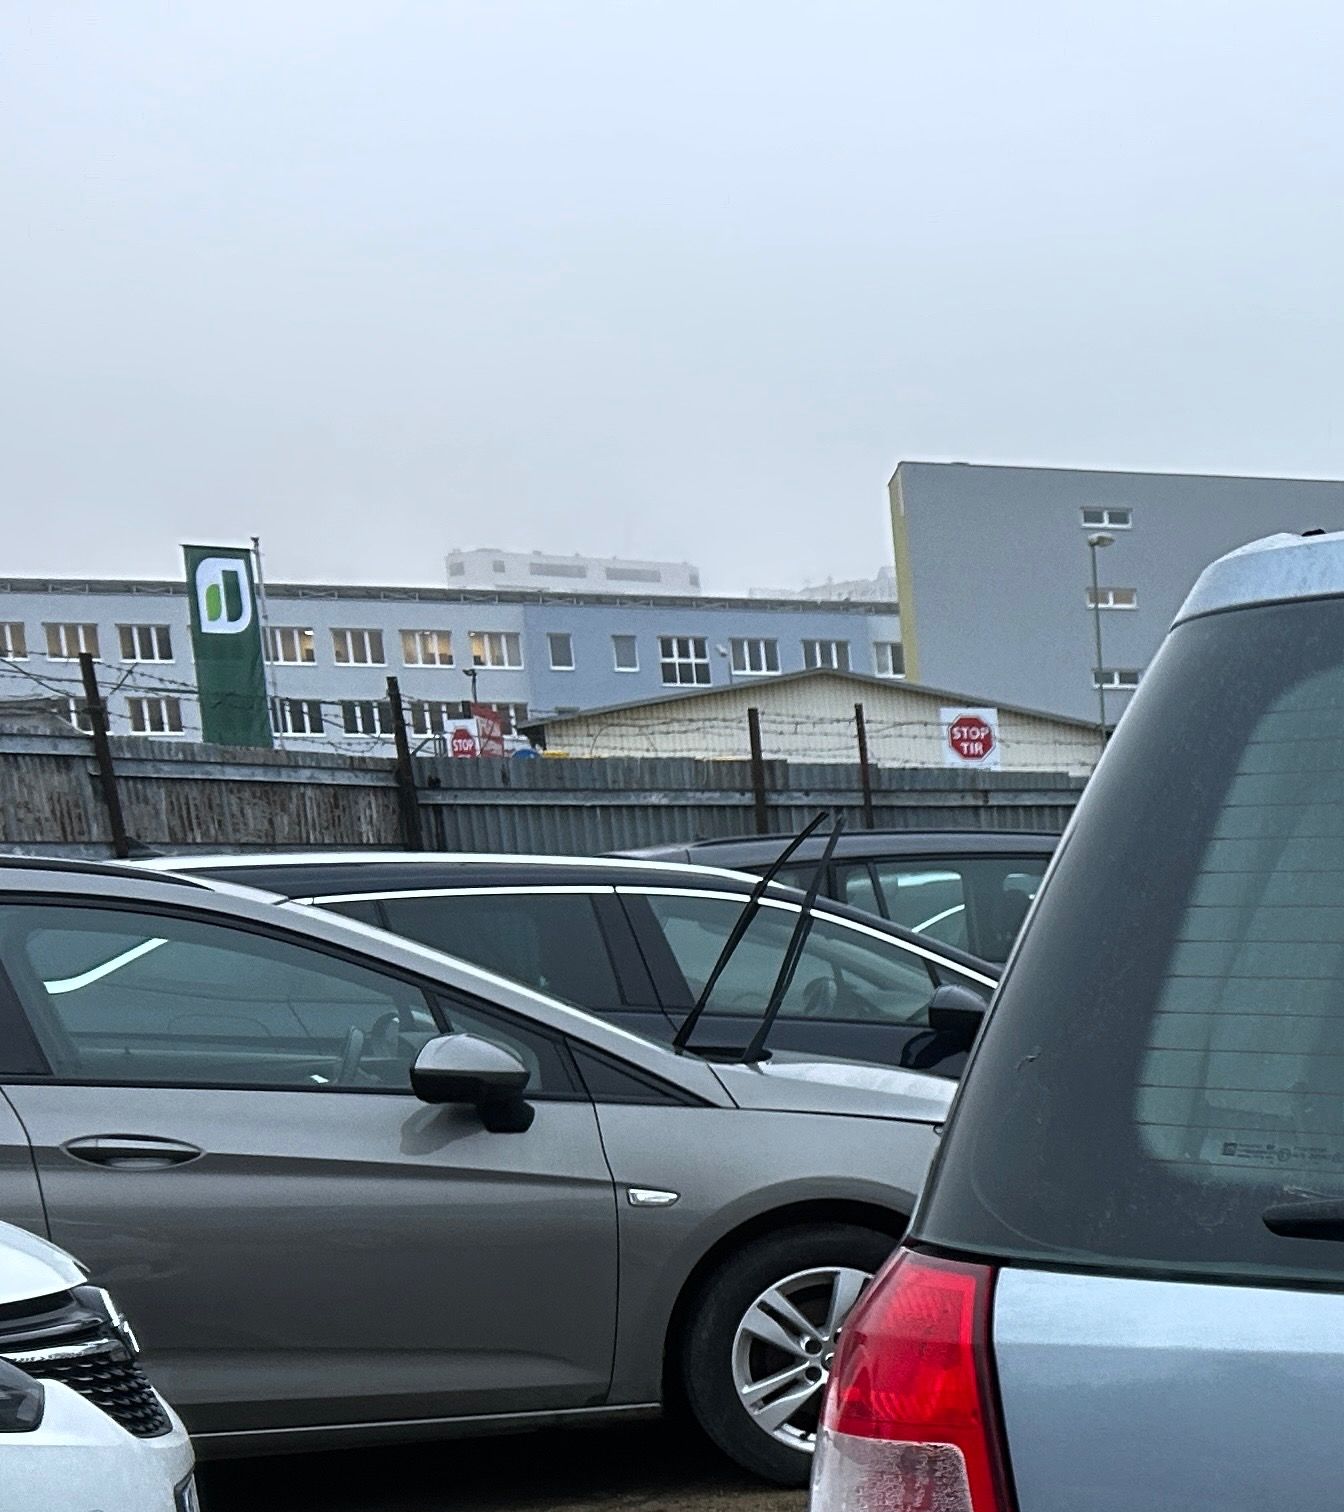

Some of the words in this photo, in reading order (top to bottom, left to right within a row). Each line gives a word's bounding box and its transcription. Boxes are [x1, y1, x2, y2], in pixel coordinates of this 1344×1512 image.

[951, 726, 990, 740] STOP
[453, 738, 474, 751] STOP
[960, 741, 984, 755] TIR
